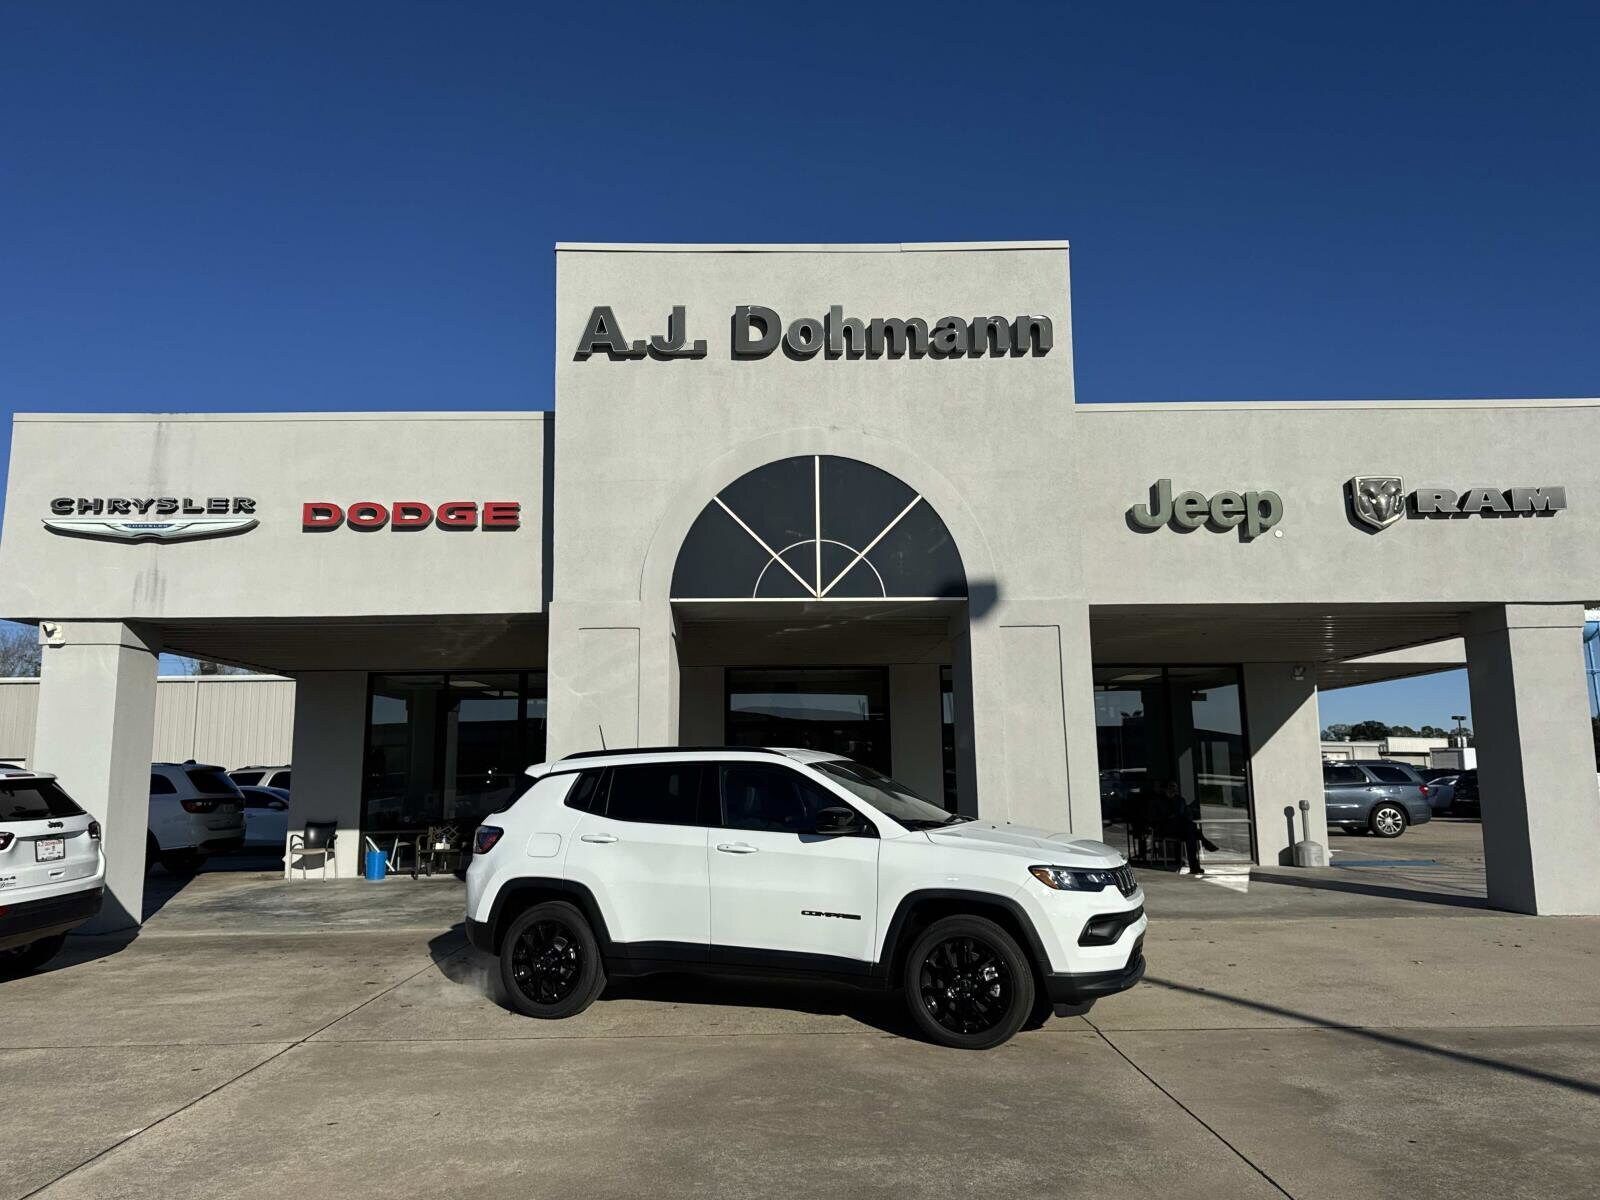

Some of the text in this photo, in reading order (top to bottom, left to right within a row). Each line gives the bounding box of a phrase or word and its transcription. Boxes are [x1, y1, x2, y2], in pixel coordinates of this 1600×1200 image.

[573, 304, 1053, 360] A.J. Dohmann
[50, 497, 257, 516] CHRYSLER
[302, 501, 521, 532] DODGE
[1125, 478, 1284, 543] Jeep
[1406, 486, 1568, 519] RAM
